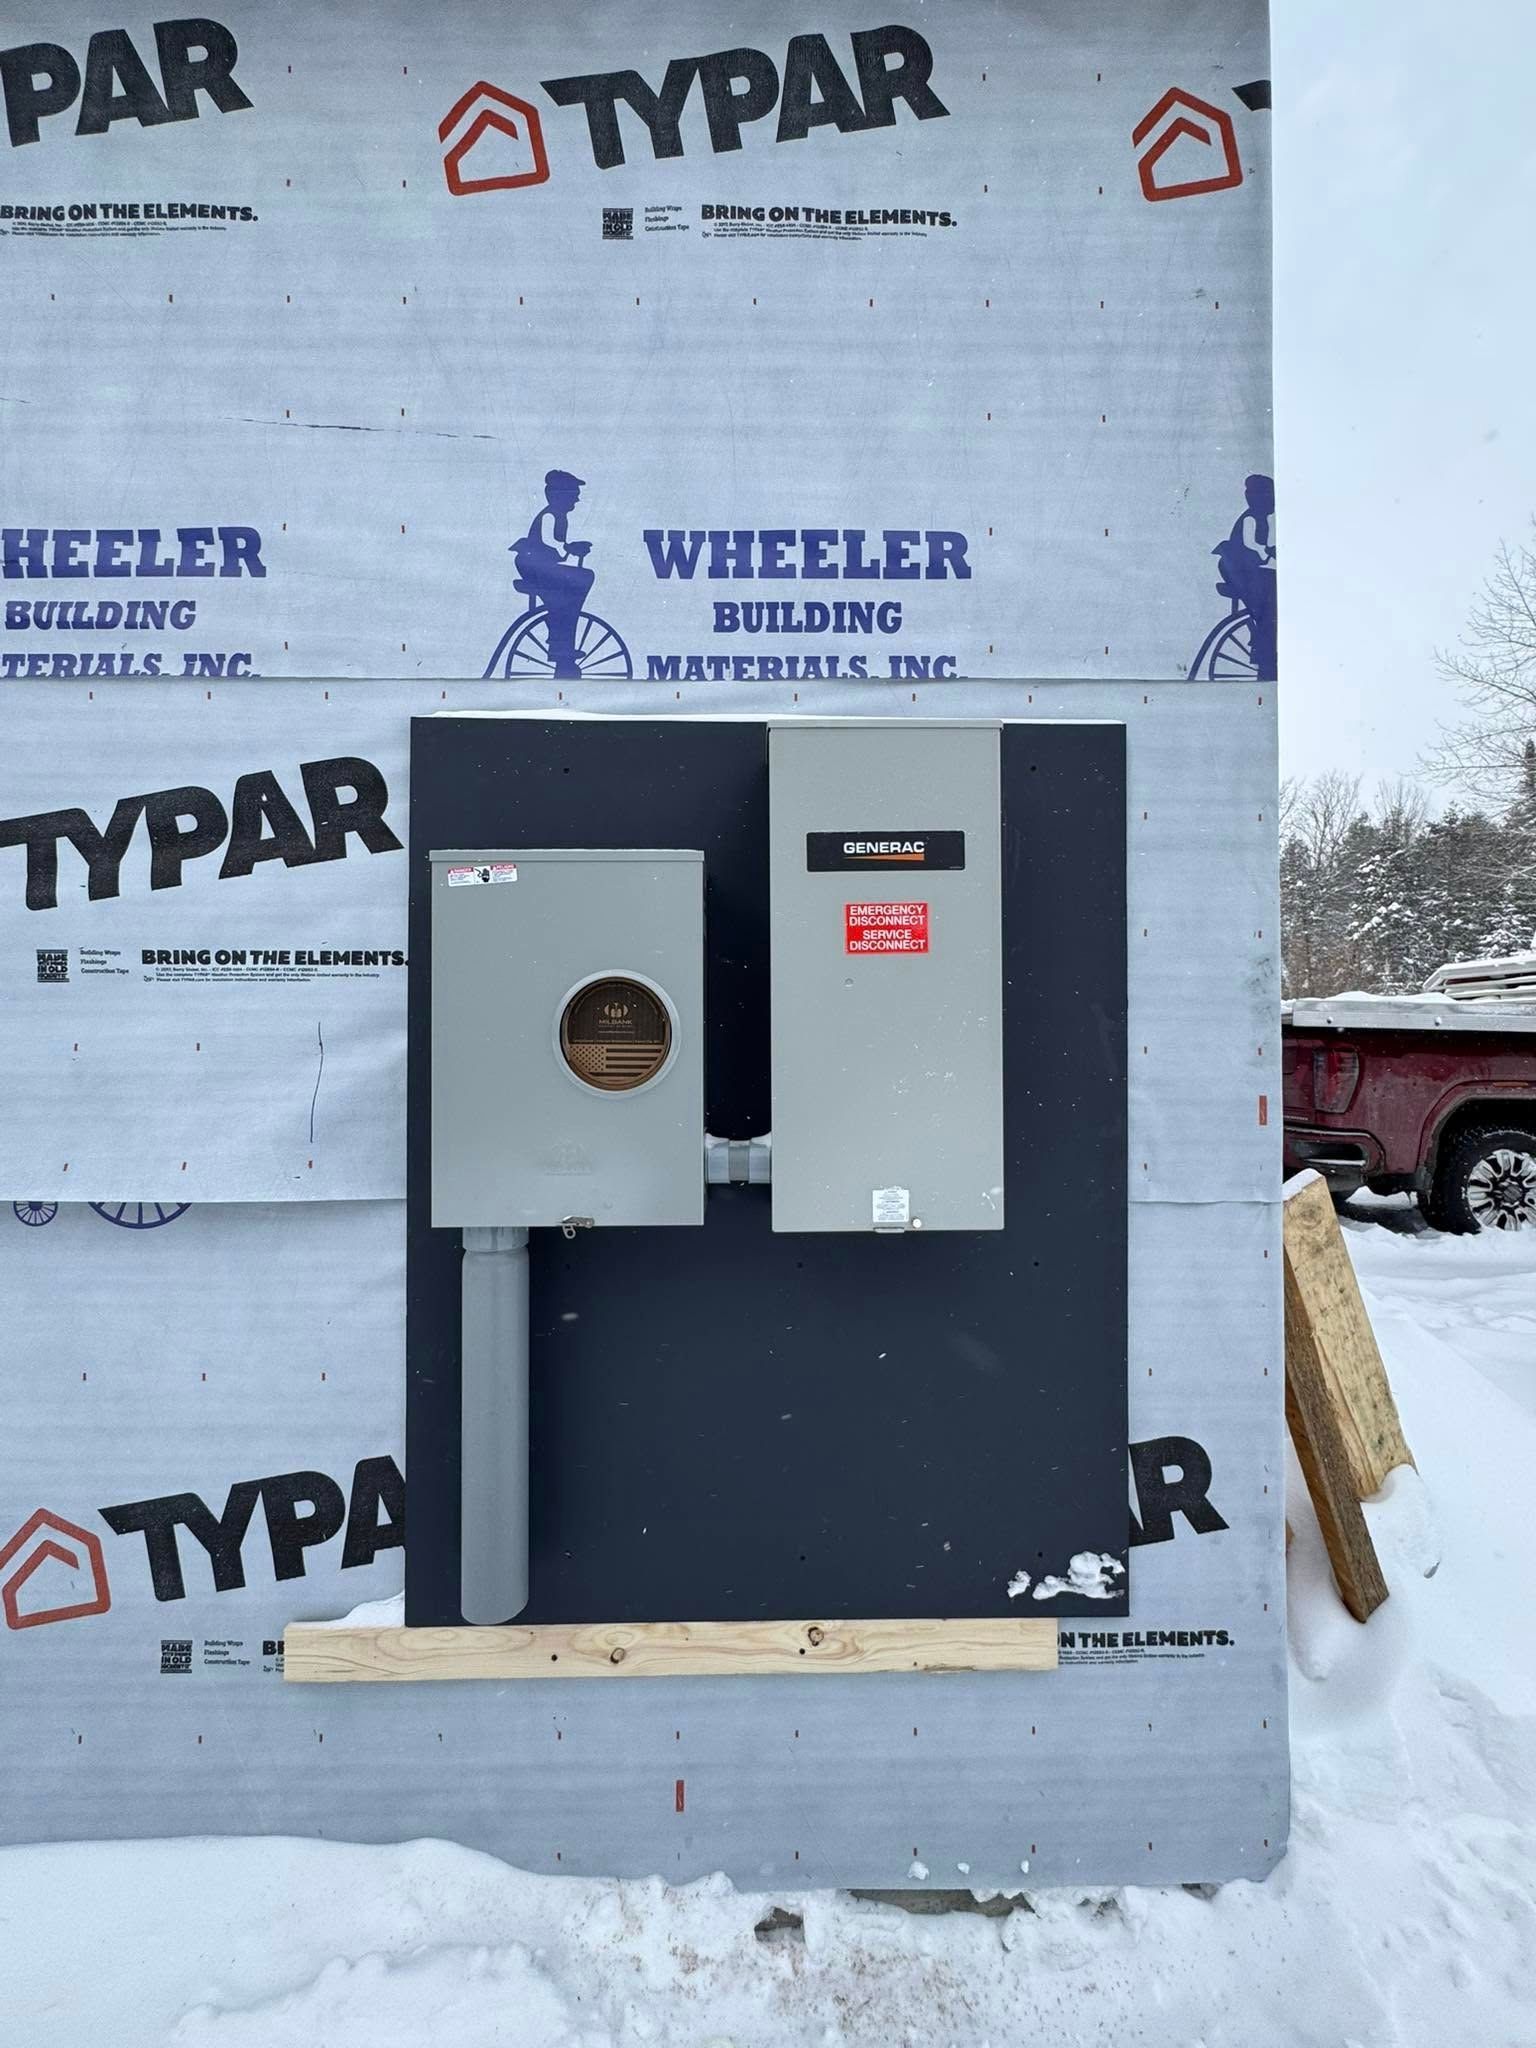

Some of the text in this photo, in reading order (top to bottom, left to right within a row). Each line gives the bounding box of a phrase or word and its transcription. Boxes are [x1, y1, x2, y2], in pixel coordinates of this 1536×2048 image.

[0, 18, 254, 147] PAR
[540, 25, 950, 169] TYPAR
[0, 203, 258, 221] BRING ON THE ELEMENTS.
[702, 204, 957, 226] BRING ON THE ELEMENTS.
[2, 527, 266, 579] HEELER
[643, 530, 971, 579] WHEELER
[5, 600, 196, 630] BUILDING
[713, 602, 902, 634] BUILDING
[2, 653, 170, 677] TERIALS
[647, 656, 968, 680] MATERIALS INC
[0, 757, 404, 911] TYPAR
[843, 842, 925, 854] GENERAC
[849, 915, 925, 926] DISCONNECT
[850, 905, 924, 916] EMERGENCY
[849, 940, 925, 950] DISCONNECT
[863, 929, 912, 940] SERVICE
[142, 950, 408, 966] BRING ON THE ELEMENTS.
[98, 1455, 405, 1602] TYPA
[1078, 1632, 1118, 1648] THE
[1123, 1630, 1235, 1647] ELEMENTS.
